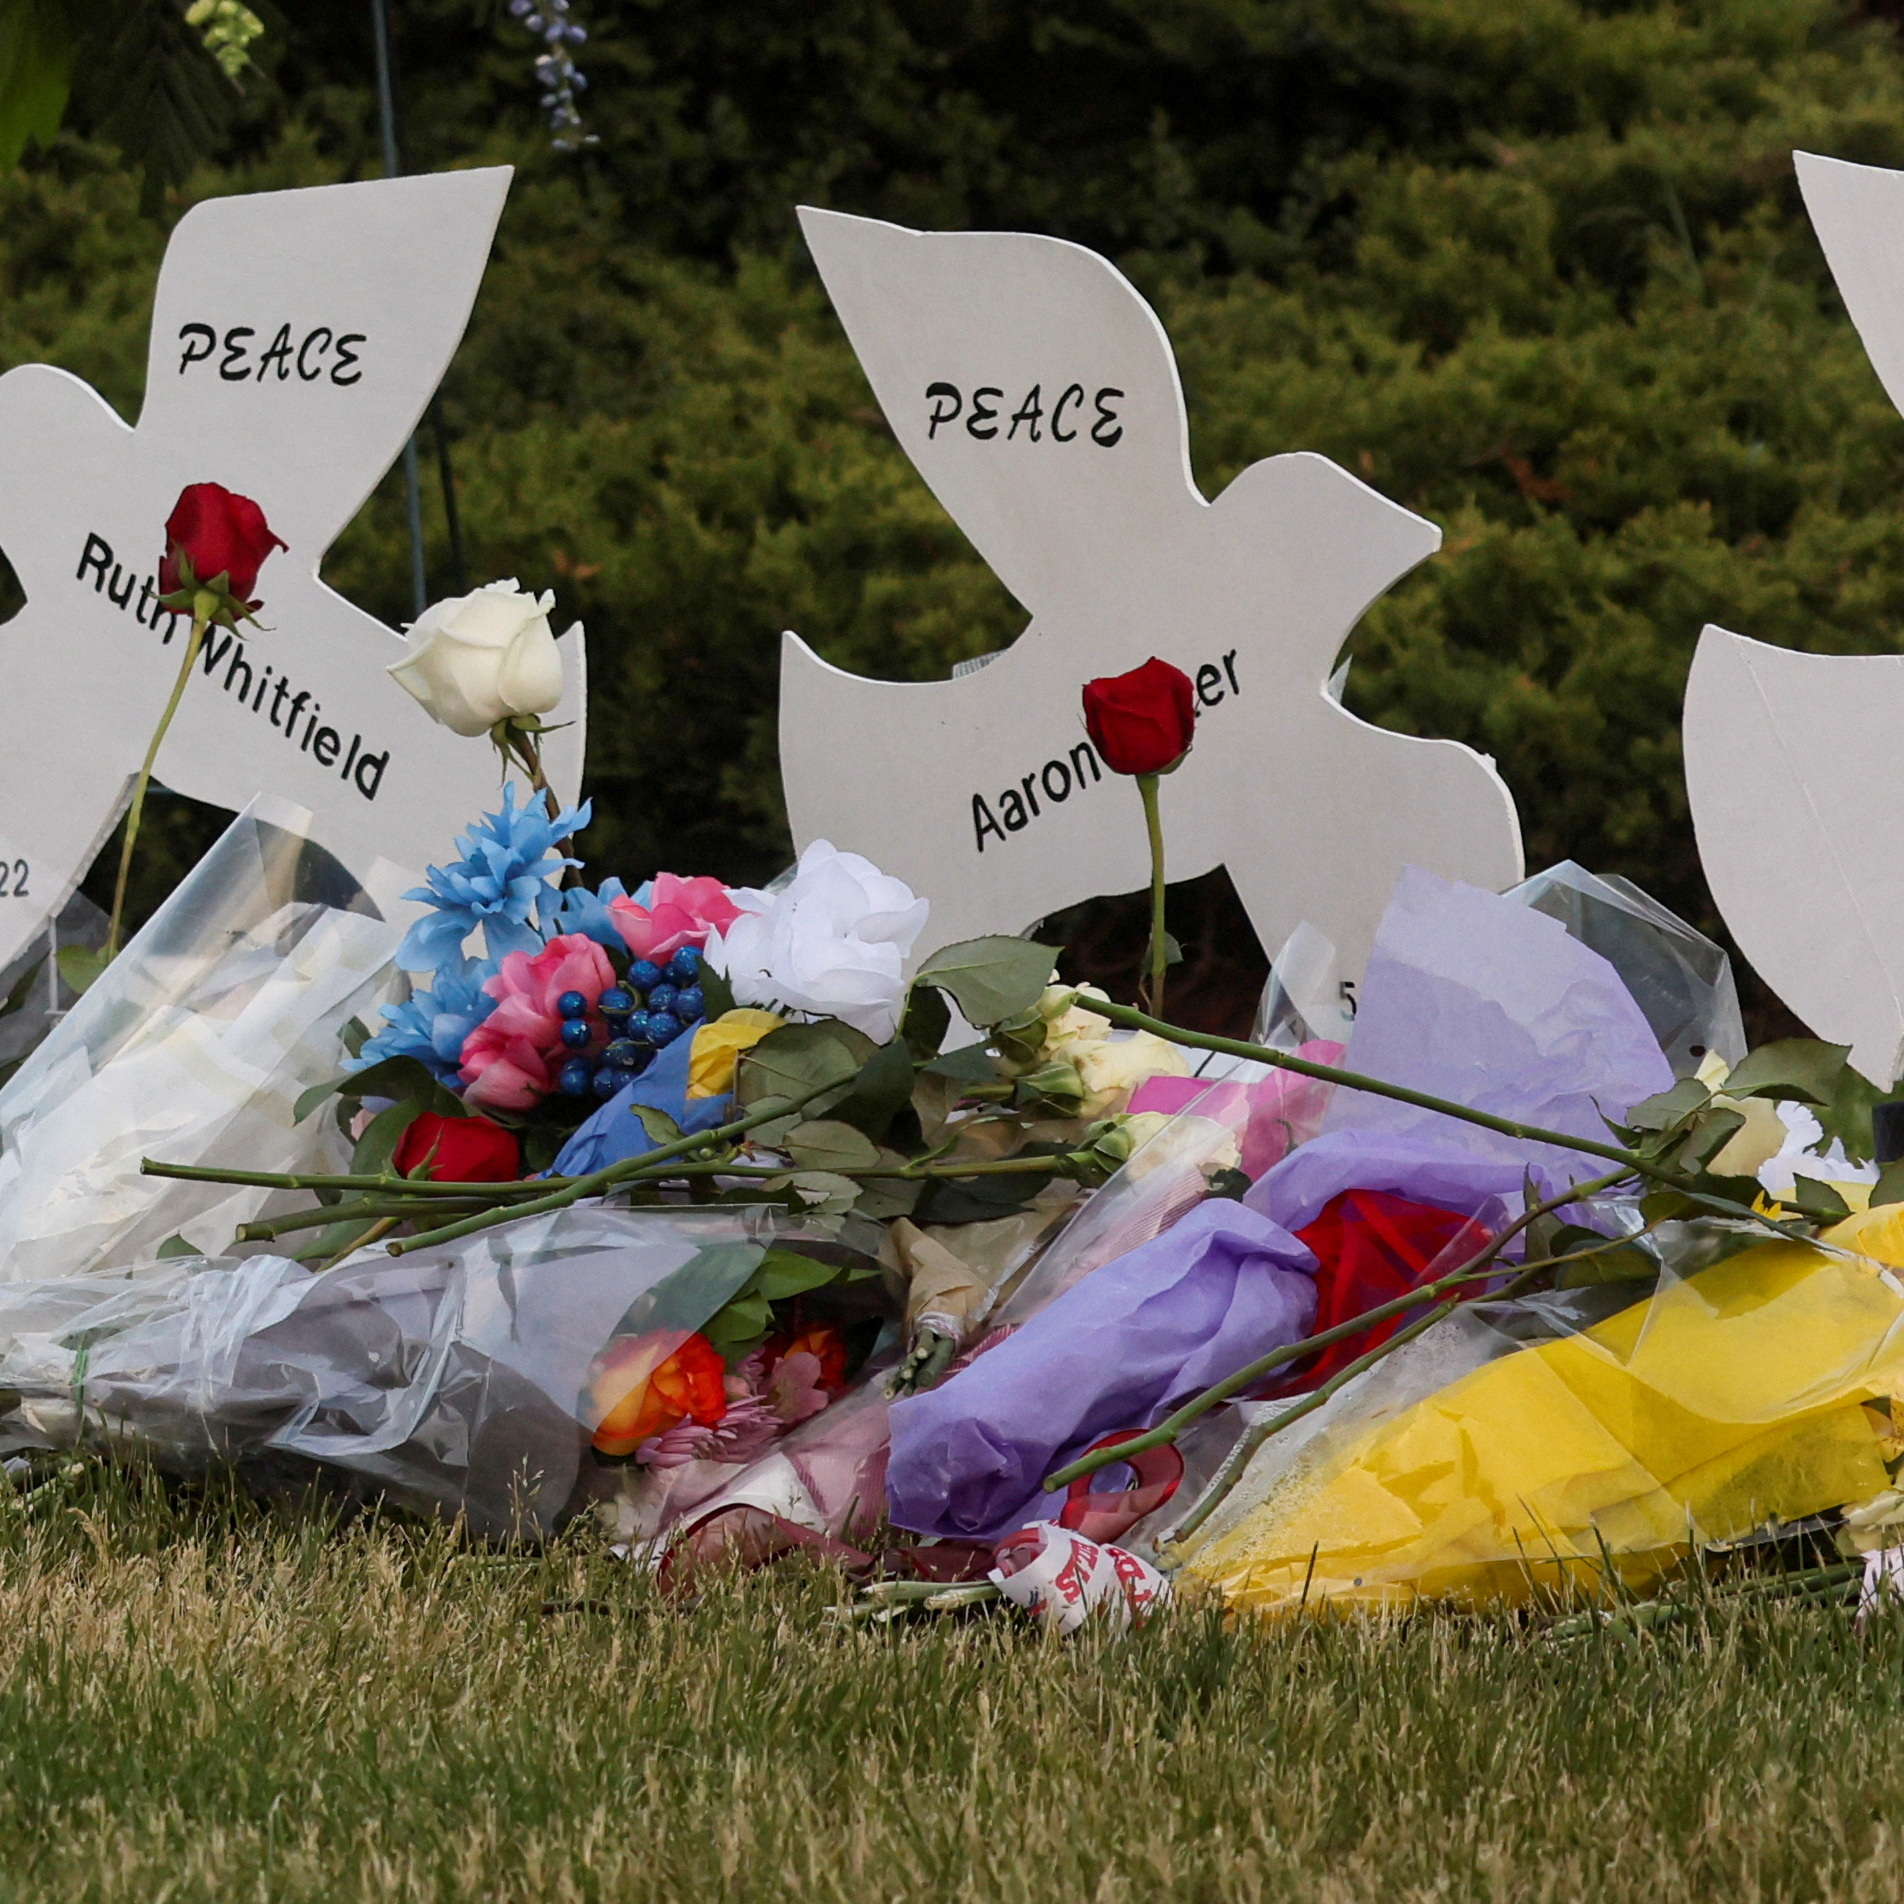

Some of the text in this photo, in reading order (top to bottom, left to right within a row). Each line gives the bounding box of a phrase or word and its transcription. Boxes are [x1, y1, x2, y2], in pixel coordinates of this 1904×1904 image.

[178, 322, 367, 386] PEACE
[925, 382, 1125, 447] PEACE
[76, 531, 178, 645] Ruth
[971, 741, 1102, 853] Aaron
